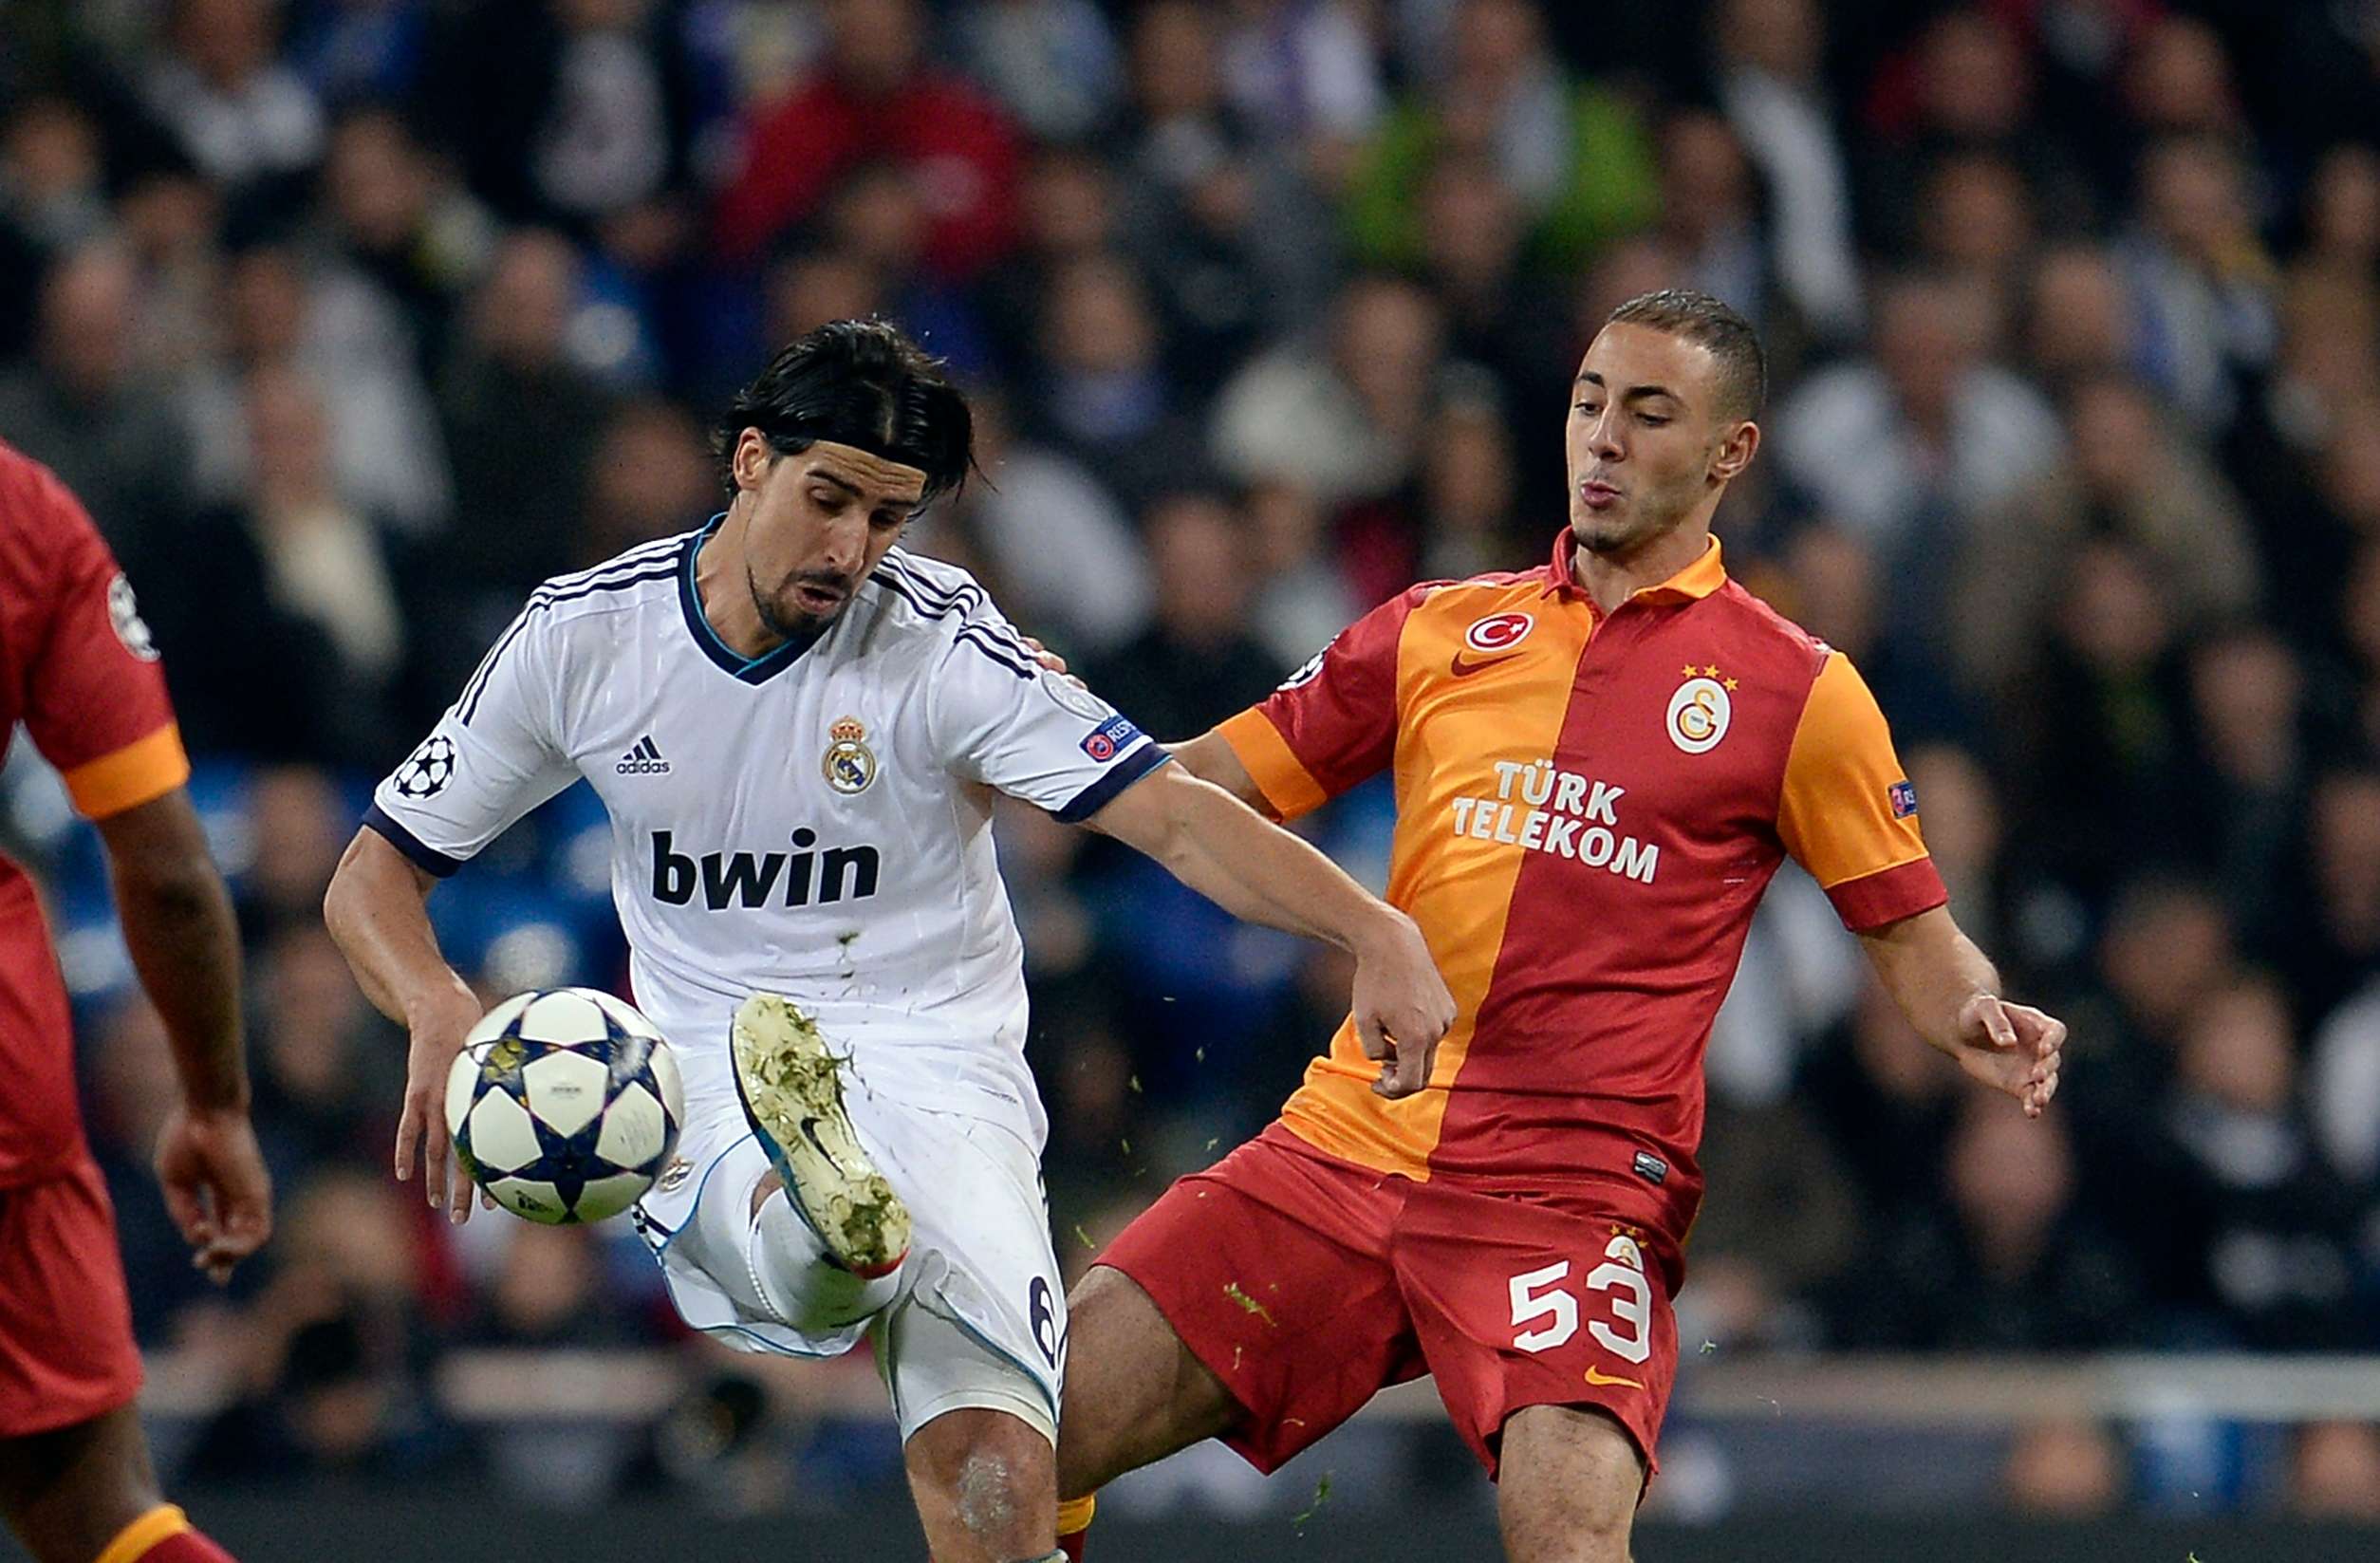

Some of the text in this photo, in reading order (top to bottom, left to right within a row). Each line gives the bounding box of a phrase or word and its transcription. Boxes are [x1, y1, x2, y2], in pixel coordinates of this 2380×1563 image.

[616, 759, 670, 774] adidas
[1494, 758, 1625, 826] TÜRK
[651, 828, 880, 911] bwin
[1452, 796, 1660, 884] TELEKOM
[1029, 1275, 1056, 1371] 6
[1509, 1260, 1652, 1365] 53
